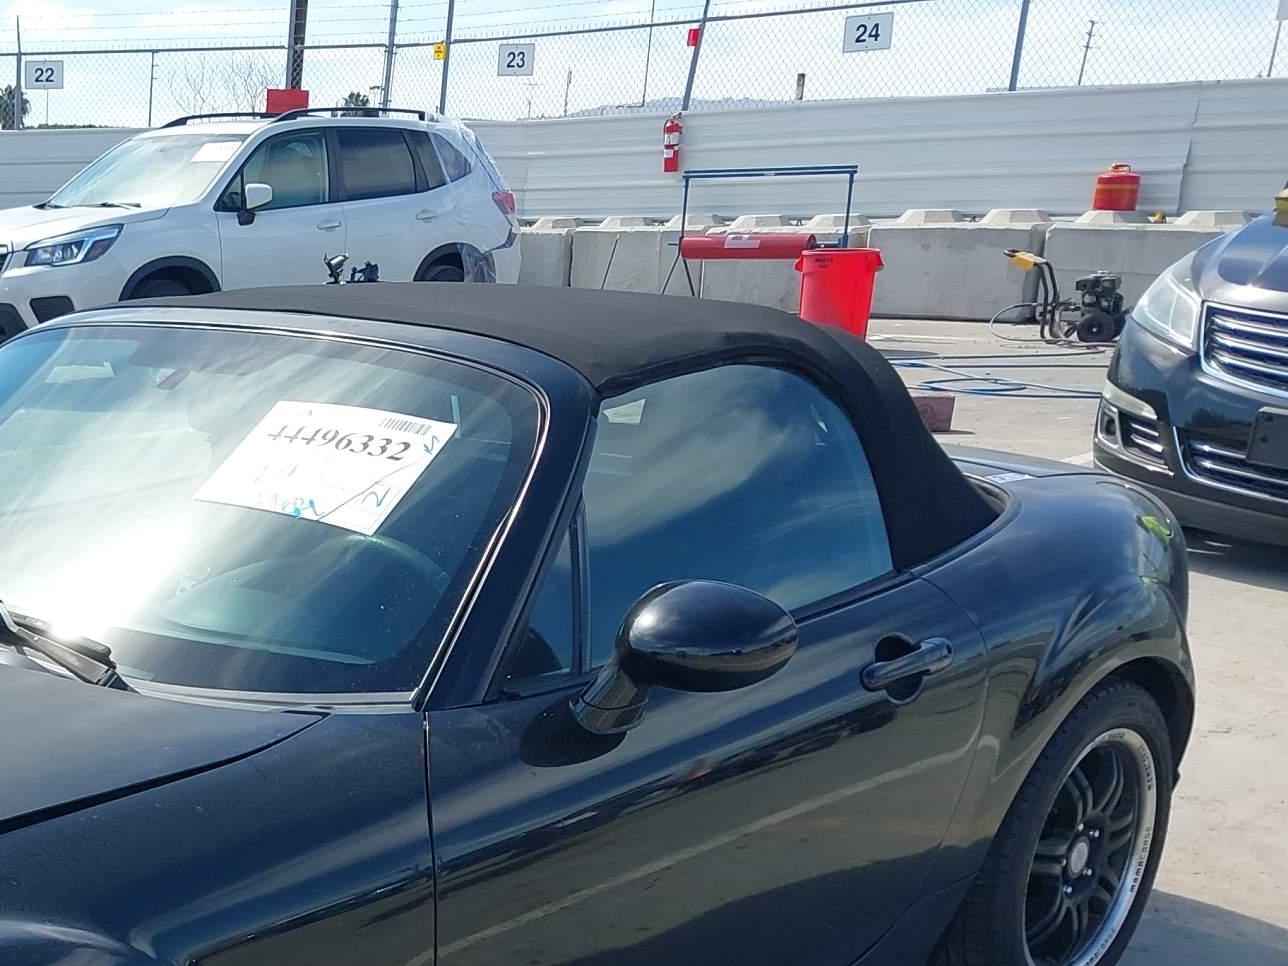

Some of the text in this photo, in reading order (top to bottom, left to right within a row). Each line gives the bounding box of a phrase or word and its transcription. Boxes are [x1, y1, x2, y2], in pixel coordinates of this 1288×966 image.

[855, 22, 881, 43] 24
[506, 51, 526, 69] 23
[34, 67, 55, 83] 22
[267, 424, 412, 461] 44496332
